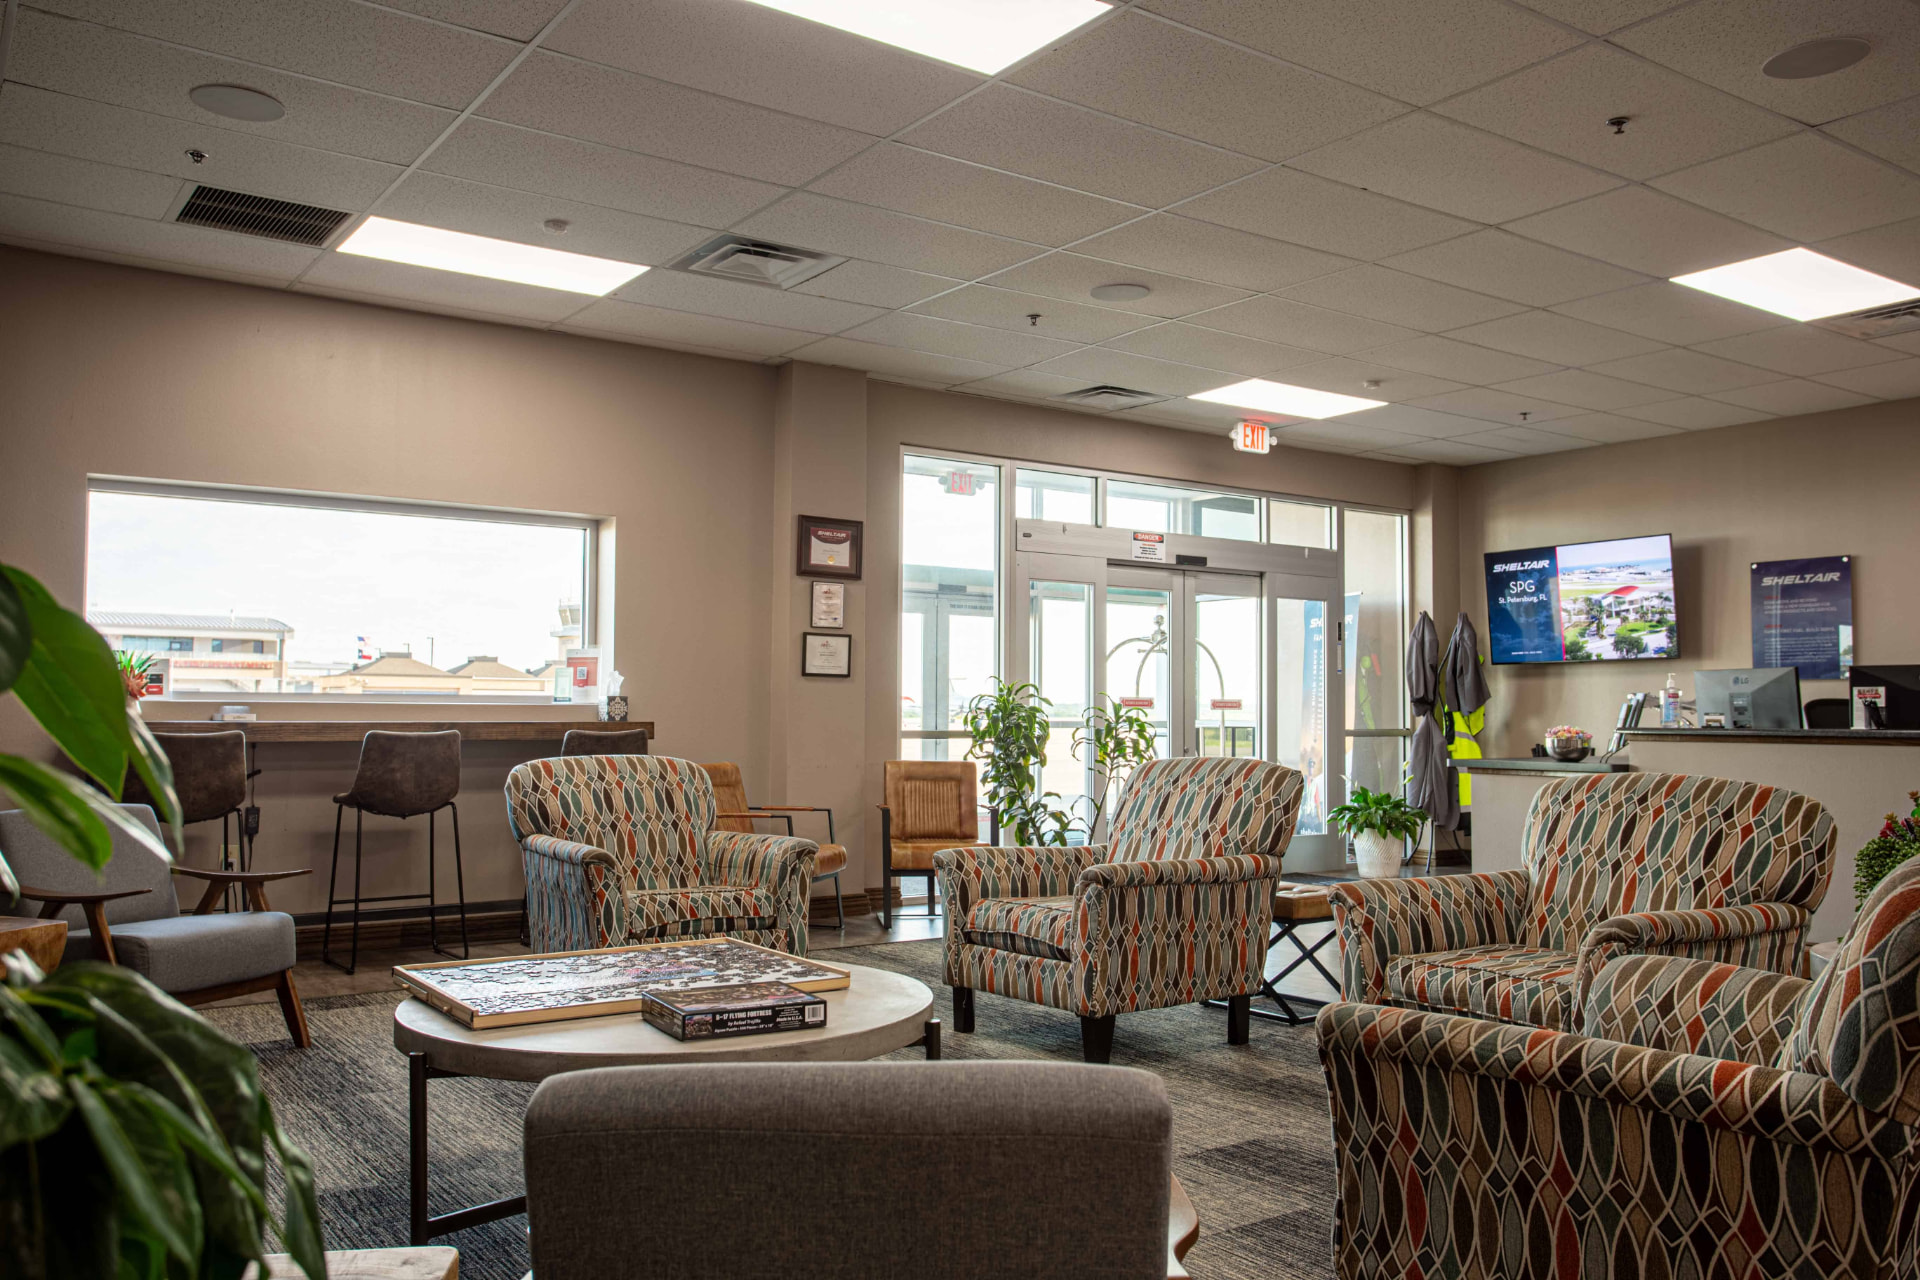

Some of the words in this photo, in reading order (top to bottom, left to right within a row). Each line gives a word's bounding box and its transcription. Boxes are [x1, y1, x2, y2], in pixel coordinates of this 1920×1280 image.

[1243, 423, 1266, 451] EXIT
[951, 471, 973, 495] EXIT
[1138, 533, 1159, 541] DANGER
[1492, 560, 1550, 573] SHELTAIR
[1761, 572, 1840, 586] SHELTAIR
[1509, 580, 1535, 593] SPG
[1539, 593, 1548, 601] FL
[1740, 677, 1749, 685] LG
[729, 1011, 746, 1019] FLYING
[747, 1009, 772, 1018] FORTRESS
